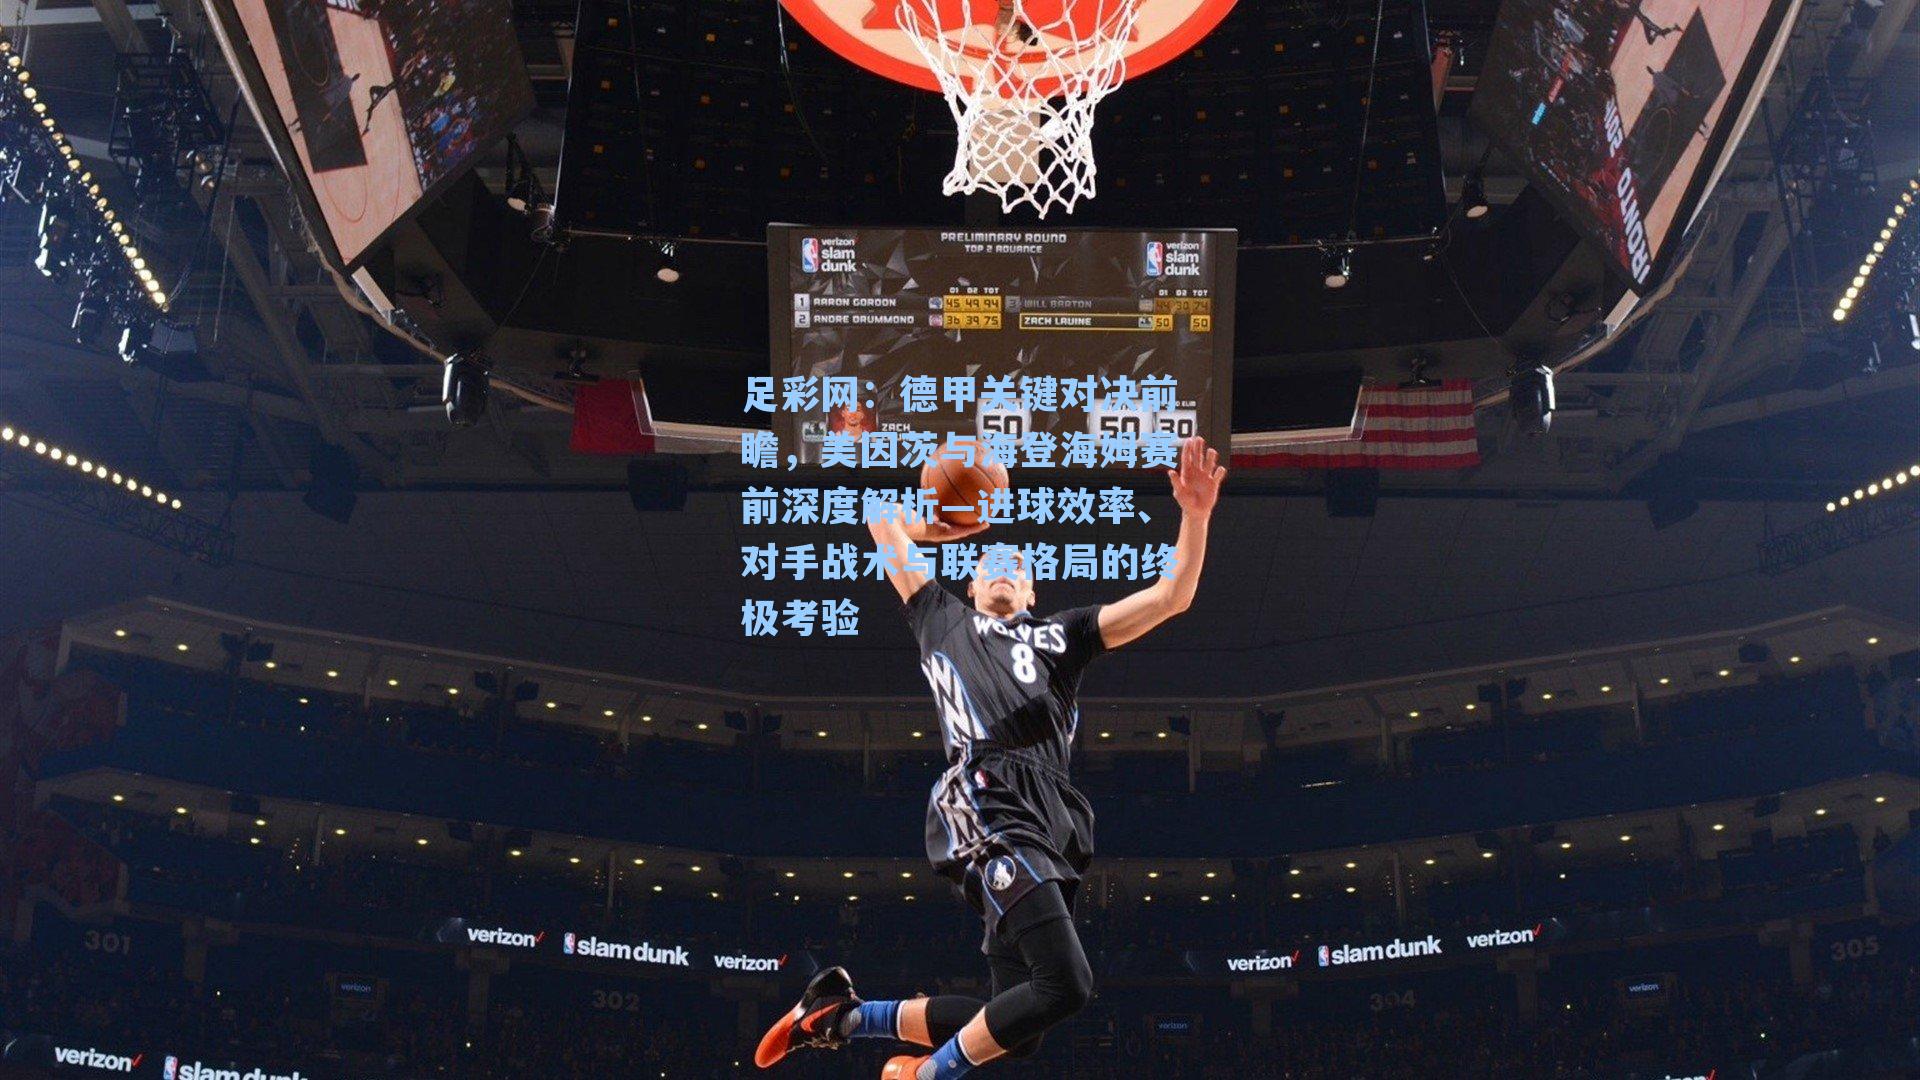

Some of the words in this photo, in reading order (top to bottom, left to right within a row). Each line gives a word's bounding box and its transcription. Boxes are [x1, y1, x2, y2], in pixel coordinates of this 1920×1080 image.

[821, 237, 856, 246] verizon
[940, 232, 1021, 242] PRELIMINARY
[1025, 233, 1067, 243] ROUND
[965, 244, 984, 253] TOP
[986, 244, 993, 253] 2
[995, 245, 1042, 254] ADVANCE
[1166, 241, 1199, 250] verizon
[821, 246, 855, 259] slam
[1166, 250, 1199, 263] slam
[821, 260, 857, 272] dunk
[1165, 263, 1200, 275] dunk
[813, 298, 850, 306] AARON
[853, 298, 896, 307] GORDON
[946, 299, 960, 308] 45
[965, 299, 979, 308] 49
[984, 299, 999, 308] 94
[799, 314, 806, 324] 2
[813, 315, 849, 324] ANDRE
[852, 315, 914, 325] DRUMMOND
[966, 316, 979, 325] 39
[984, 316, 999, 325] 75
[1024, 317, 1052, 325] ZACH
[1054, 317, 1092, 325] LAVINE
[1156, 318, 1170, 327] 50
[1193, 318, 1208, 327] 50
[881, 423, 910, 431] ZACH
[983, 416, 1023, 439] 50
[1100, 416, 1141, 441] 50
[1160, 418, 1194, 439] 30
[1011, 643, 1036, 683] 8
[467, 927, 536, 947] verizon
[1466, 928, 1534, 948] verizon
[576, 935, 632, 960] slam
[632, 941, 690, 967] dunk
[1331, 944, 1384, 965] slam
[1385, 934, 1443, 960] dunk
[714, 953, 779, 971] verizon
[1227, 953, 1292, 971] verizon
[55, 1046, 132, 1072] verizon
[178, 1061, 241, 1080] slam
